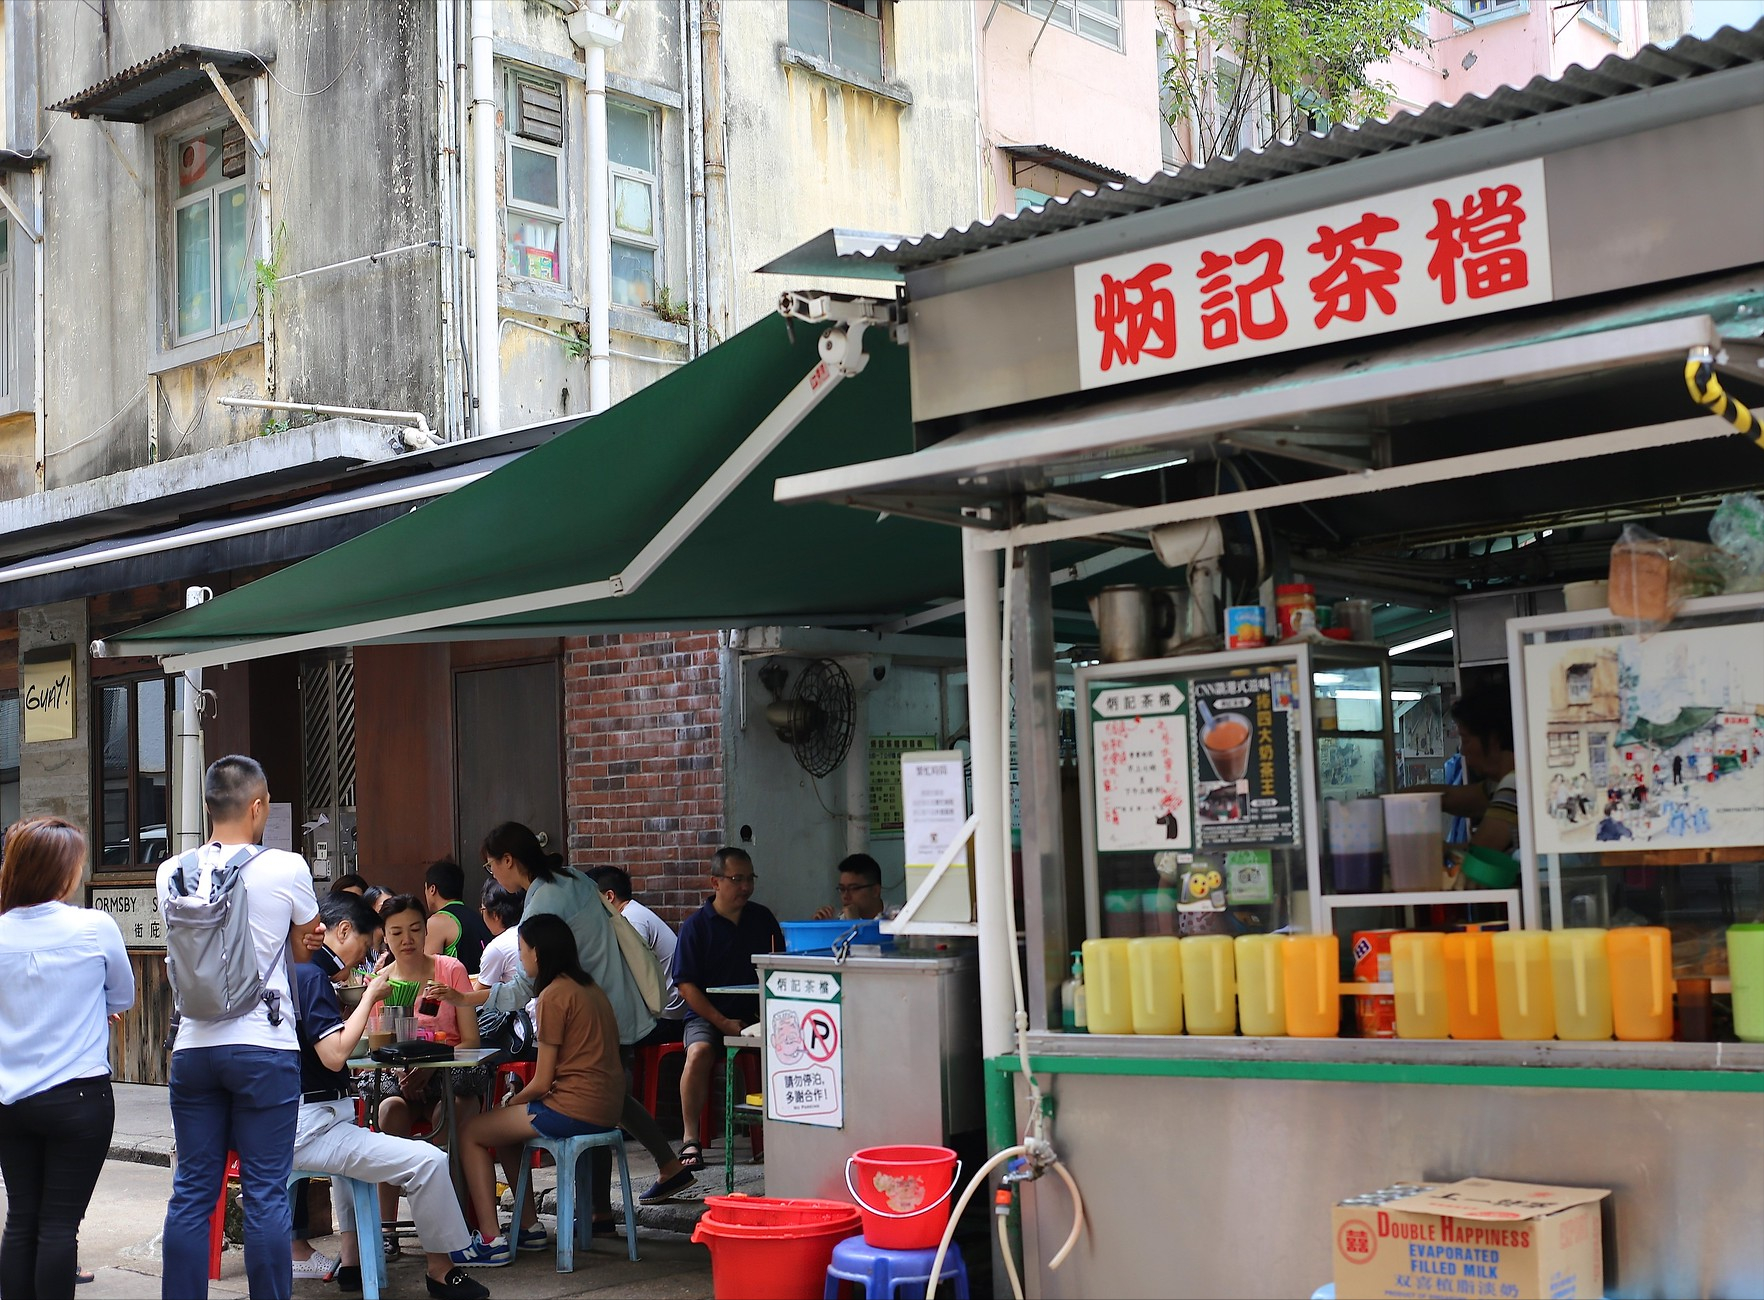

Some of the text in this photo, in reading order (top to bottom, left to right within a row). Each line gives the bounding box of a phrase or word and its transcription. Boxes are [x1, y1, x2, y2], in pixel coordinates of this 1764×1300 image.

[1095, 183, 1529, 371] 炳記茶檔
[1106, 692, 1171, 711] 炳記茶檔
[1257, 692, 1275, 795] 四大奶茶王
[95, 896, 137, 913] ORMSBY
[776, 978, 829, 994] 炳記茶檔
[1377, 1211, 1436, 1242] DOUBLE
[1440, 1215, 1531, 1249] HAPPINESS
[1409, 1243, 1500, 1264] EVAPORATED
[1411, 1259, 1498, 1279] FILLED MILK
